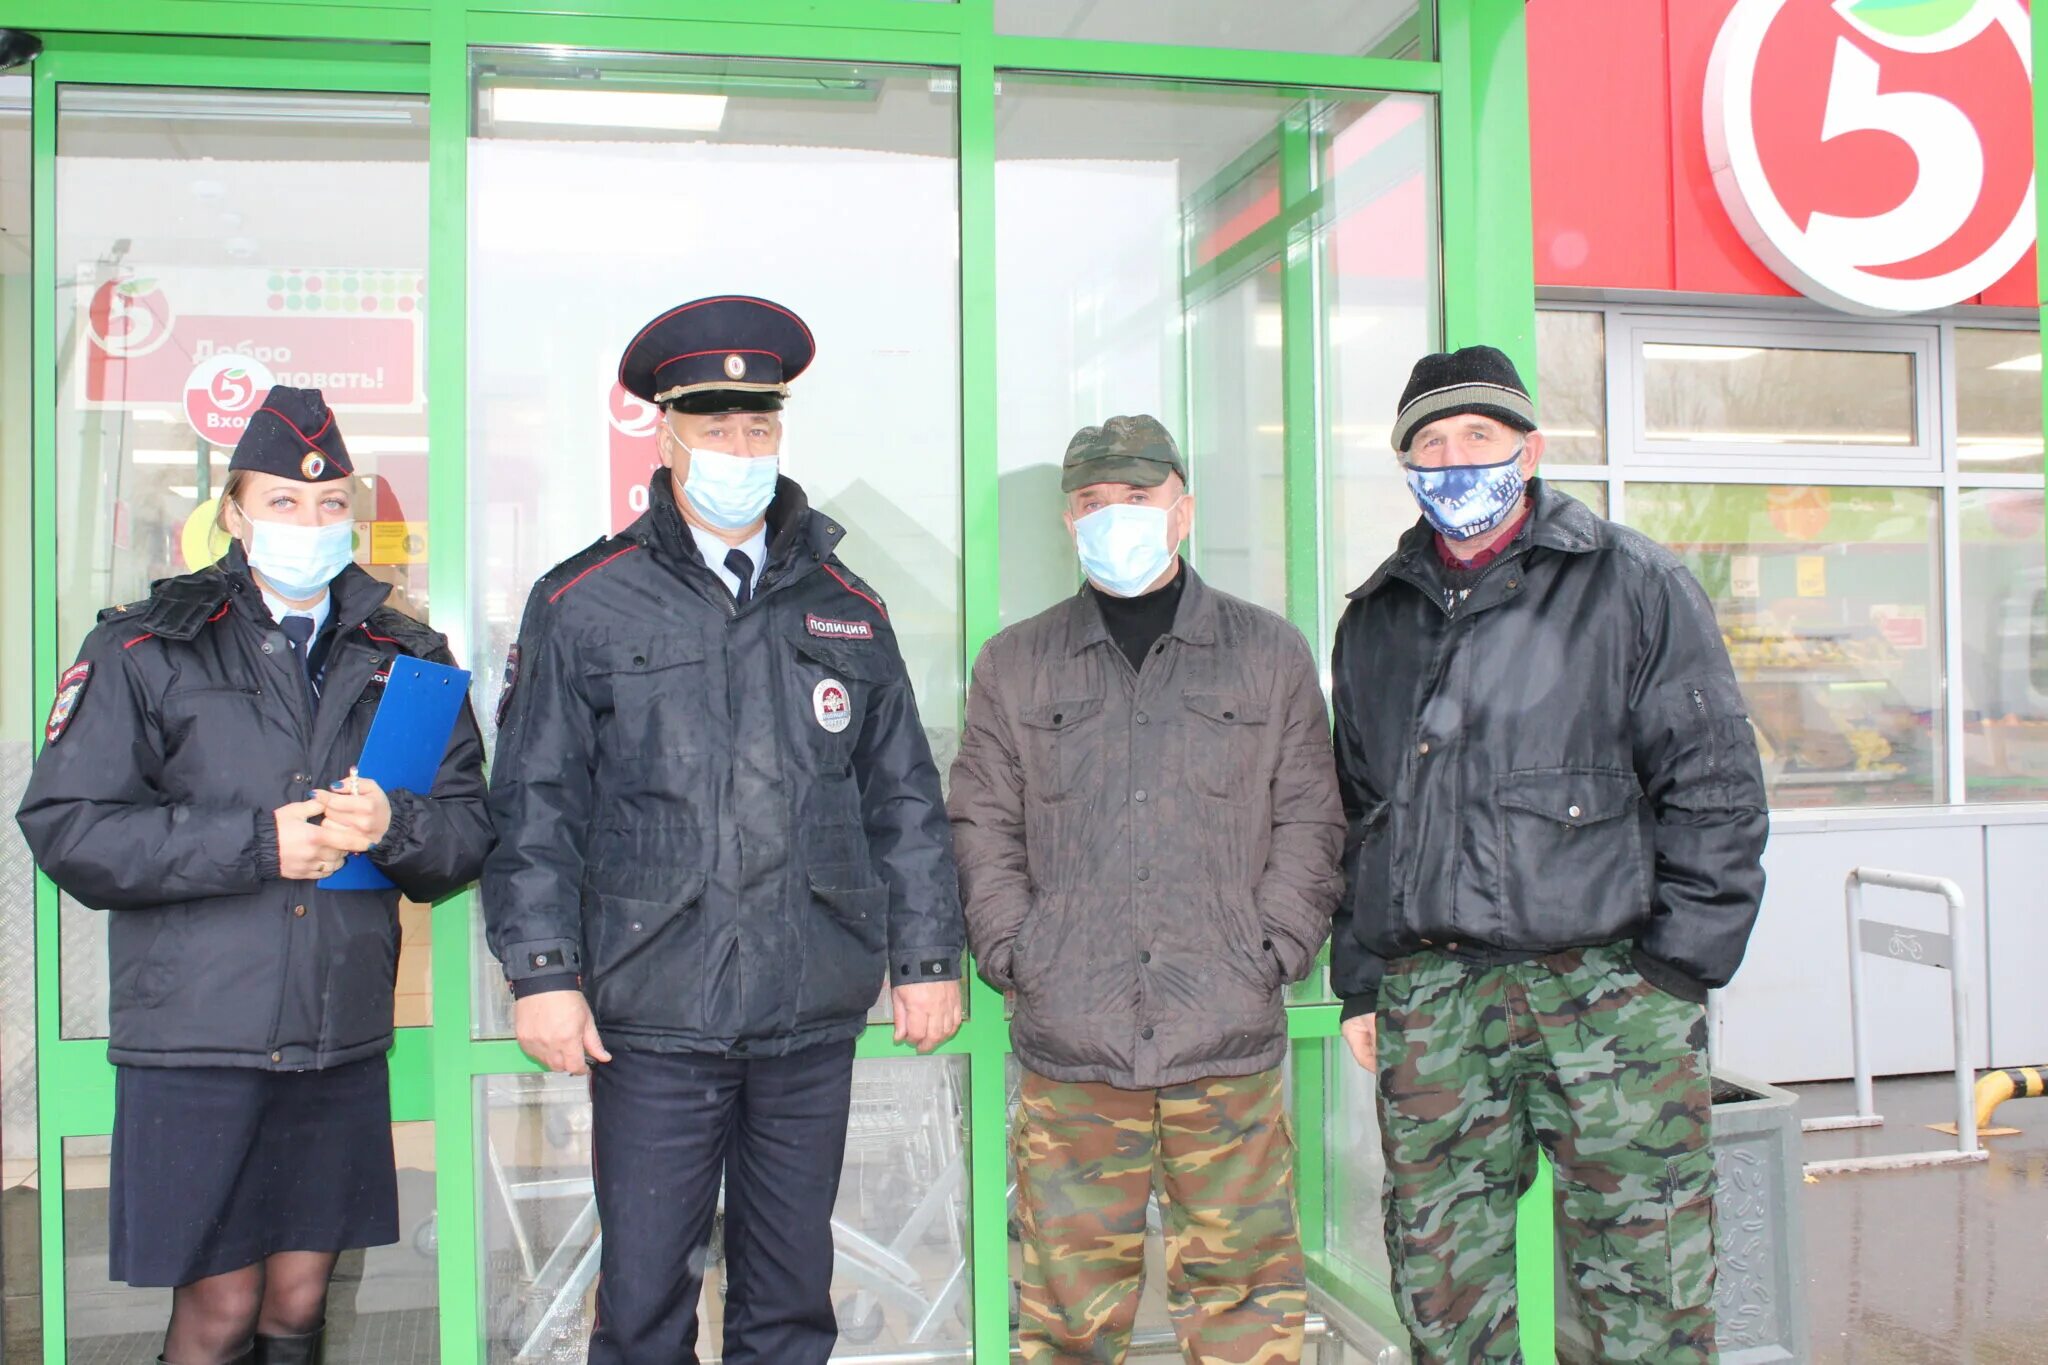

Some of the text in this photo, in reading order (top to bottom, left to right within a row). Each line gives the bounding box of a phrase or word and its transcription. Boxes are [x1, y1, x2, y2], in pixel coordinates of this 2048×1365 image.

[1803, 36, 1985, 268] 5
[193, 339, 292, 365] Добро
[276, 367, 385, 389] ловать!
[216, 378, 245, 407] 5
[206, 412, 250, 429] Вхо
[809, 619, 868, 636] ПОЛИЦИЯ
